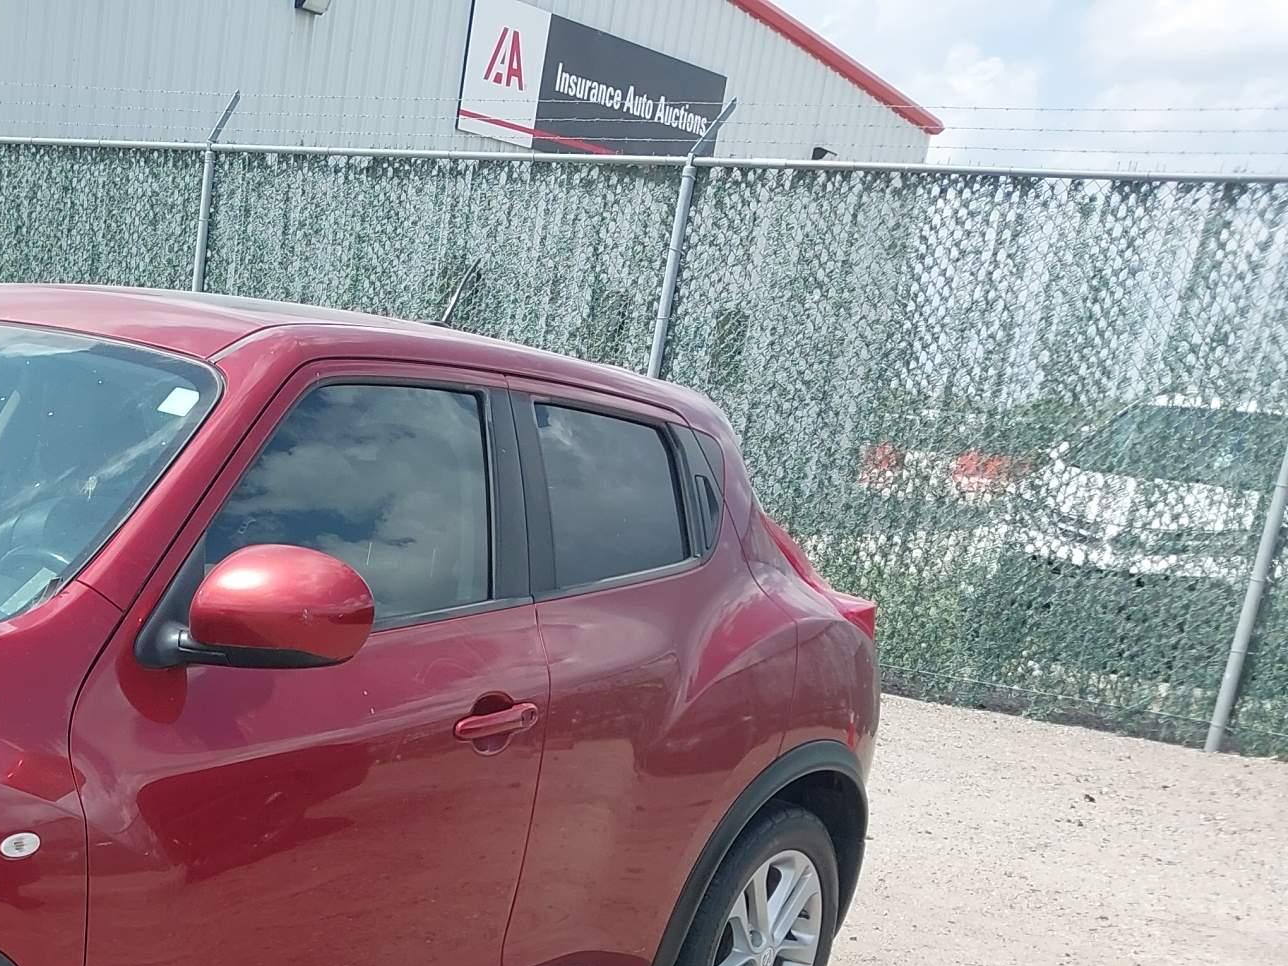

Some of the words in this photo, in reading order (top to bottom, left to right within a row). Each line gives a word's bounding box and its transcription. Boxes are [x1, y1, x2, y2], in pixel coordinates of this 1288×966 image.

[555, 62, 623, 110] Insurance
[622, 85, 654, 120] Auto
[654, 96, 708, 137] Auctions
